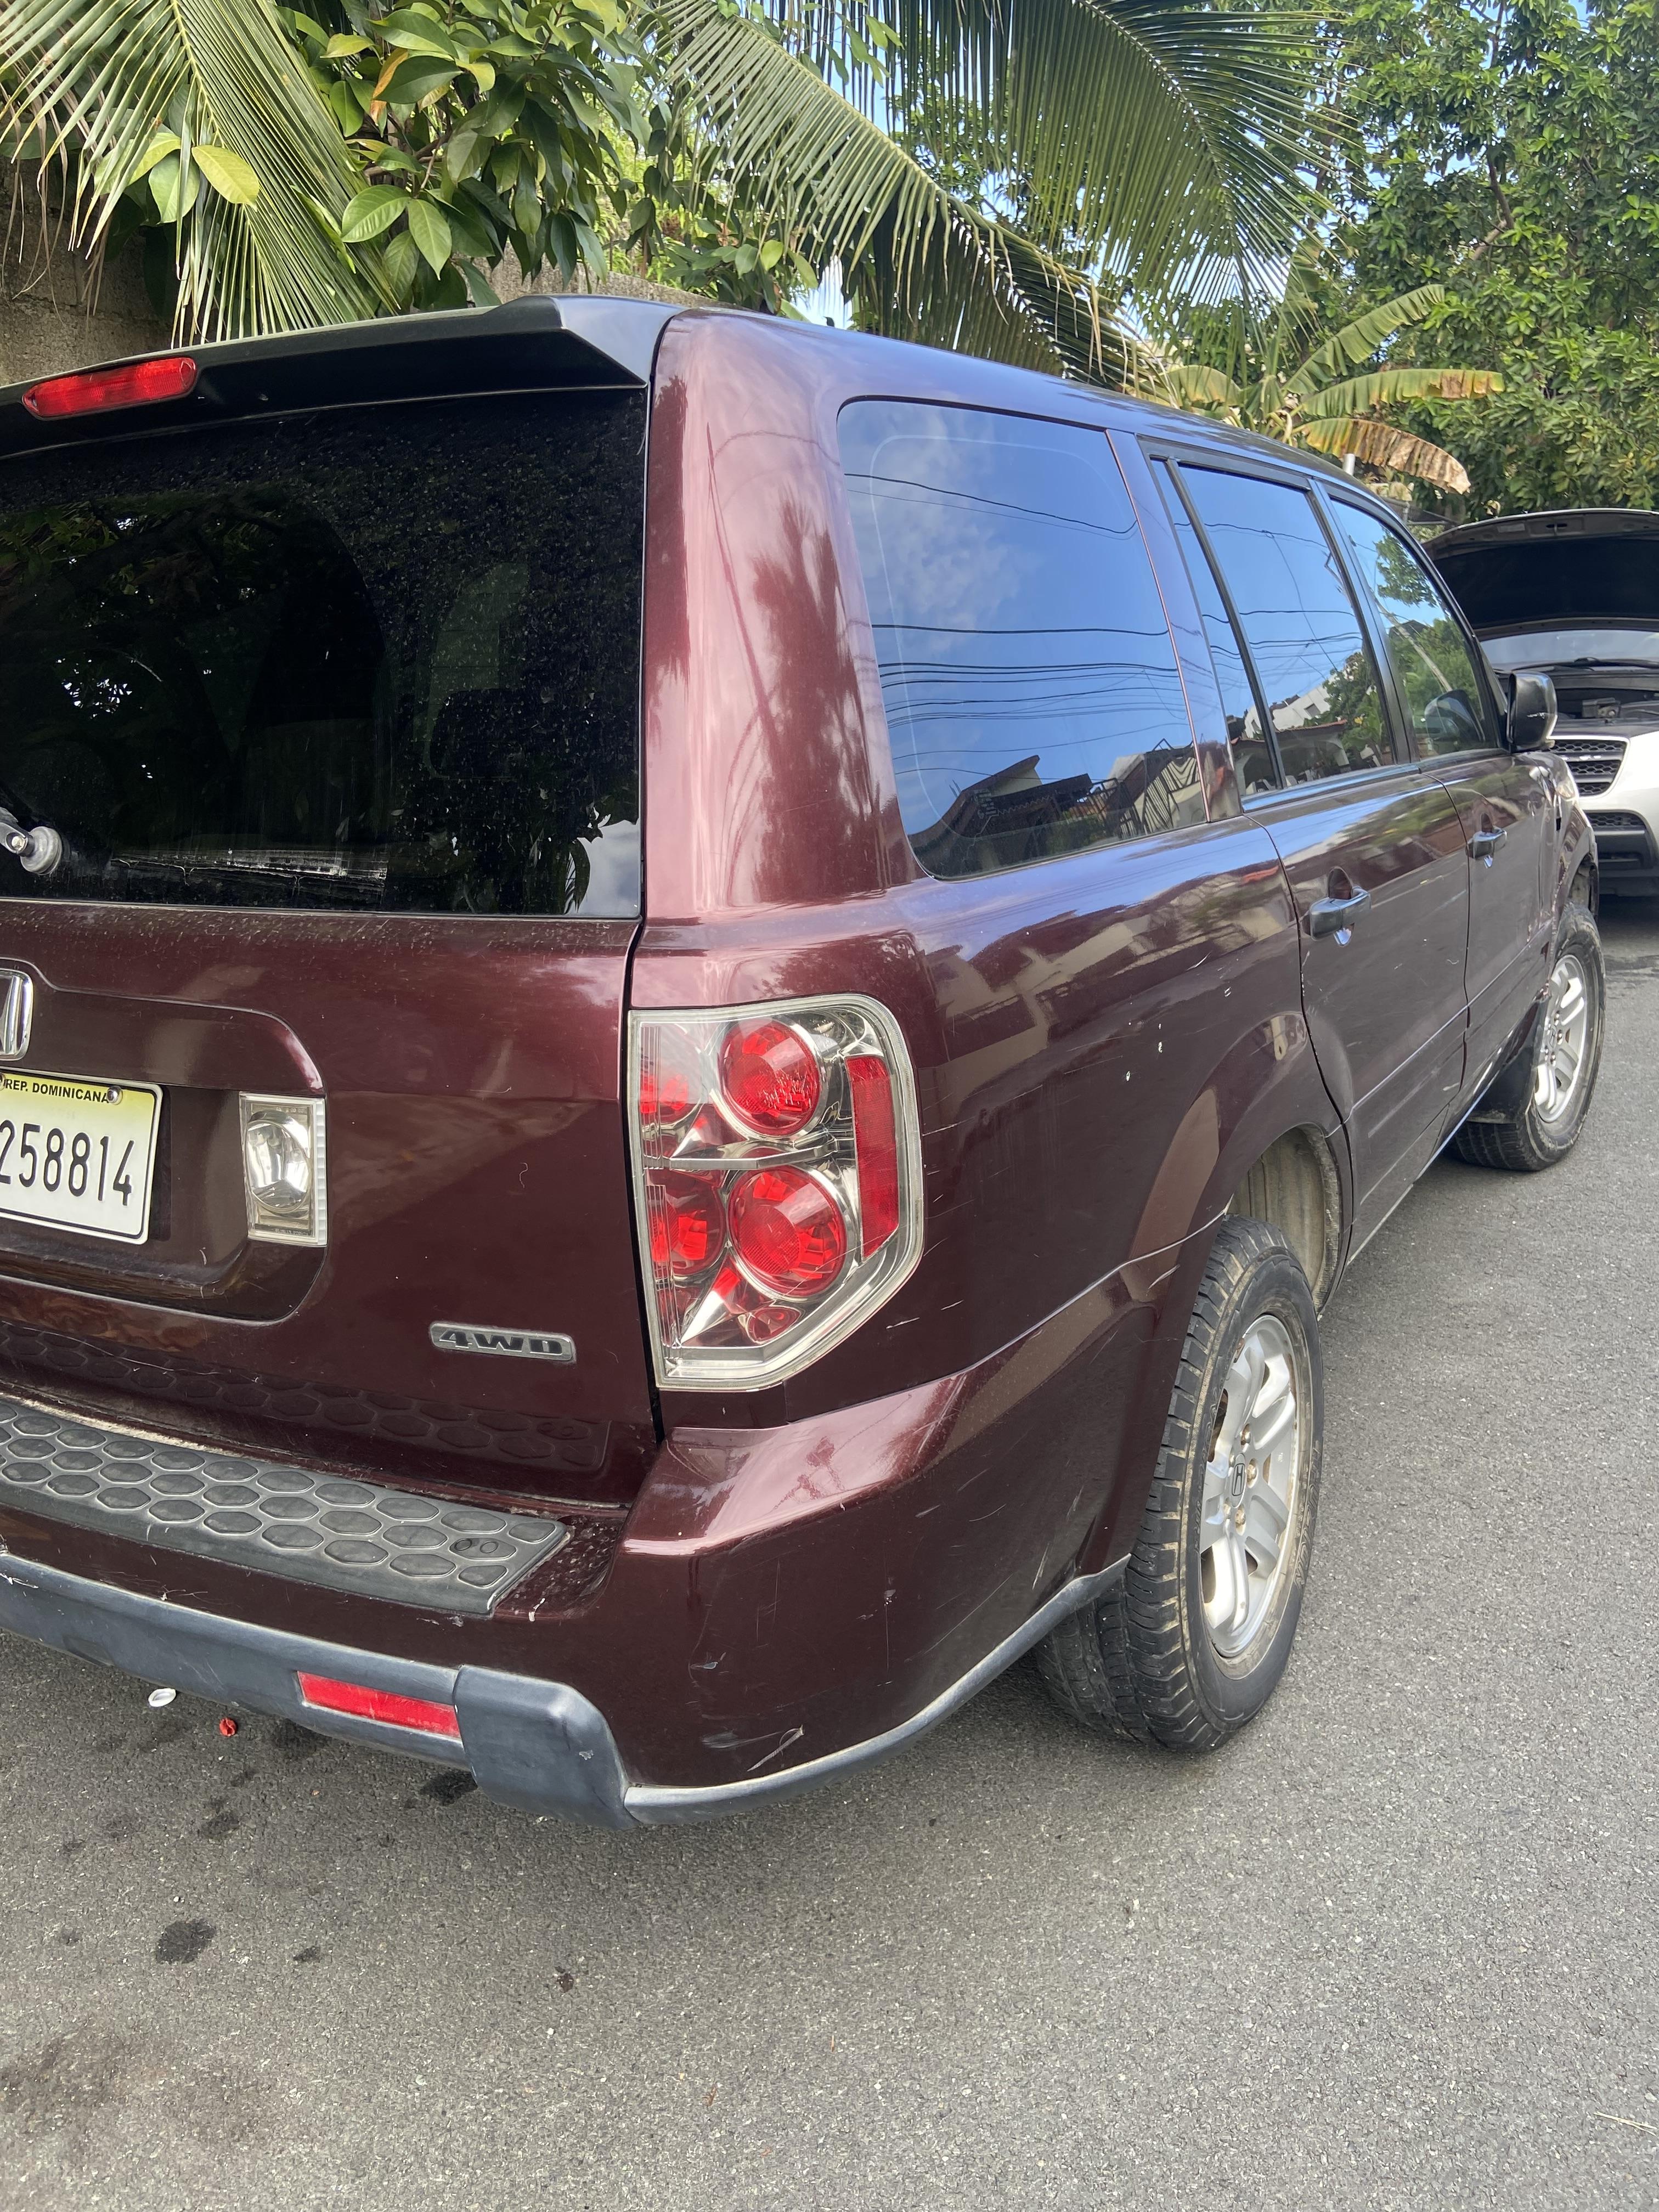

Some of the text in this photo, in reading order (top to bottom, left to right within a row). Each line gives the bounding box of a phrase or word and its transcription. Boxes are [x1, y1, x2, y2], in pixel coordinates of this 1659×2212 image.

[5, 1079, 109, 1104] REP. DOMINICANA
[0, 1119, 134, 1206] 258814
[439, 1329, 563, 1356] 4WD
